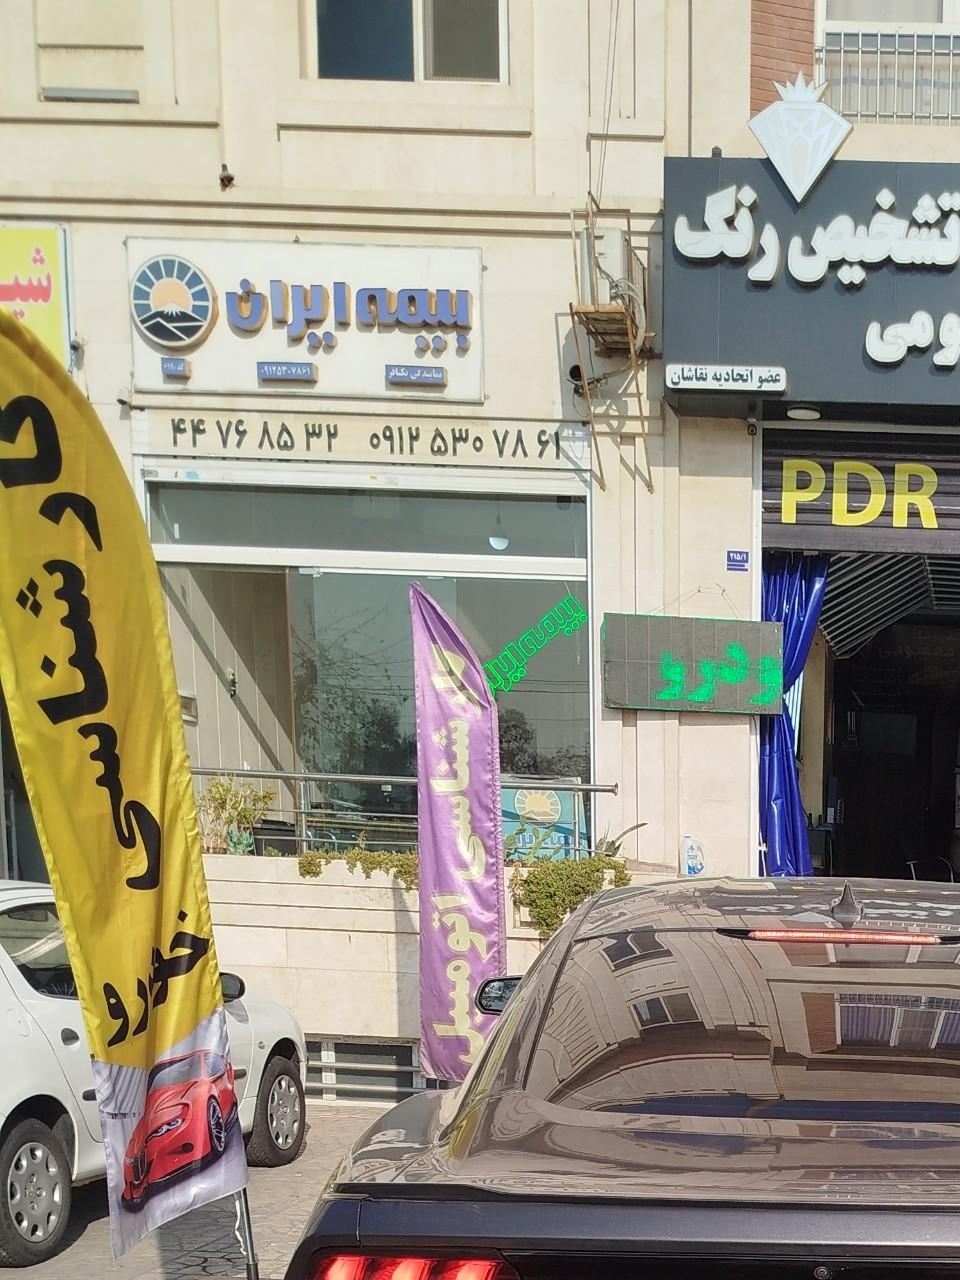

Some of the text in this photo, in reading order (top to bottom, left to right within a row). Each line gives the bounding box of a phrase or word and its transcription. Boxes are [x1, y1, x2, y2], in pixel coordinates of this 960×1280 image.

[226, 278, 473, 352] بیمه ایران
[671, 366, 781, 388] عضو اتحادیه نقاشان
[171, 417, 339, 452] ۴۴ ۷۶ ۸۵ ۳۲
[369, 424, 561, 460] ۰۹۱۲ ۵۳۰ ۷۸ ۶۱
[780, 459, 939, 529] PDR
[484, 593, 588, 699] بیمه ایرا
[103, 909, 211, 1048] خورو
[431, 894, 487, 1065] اتومبیل
